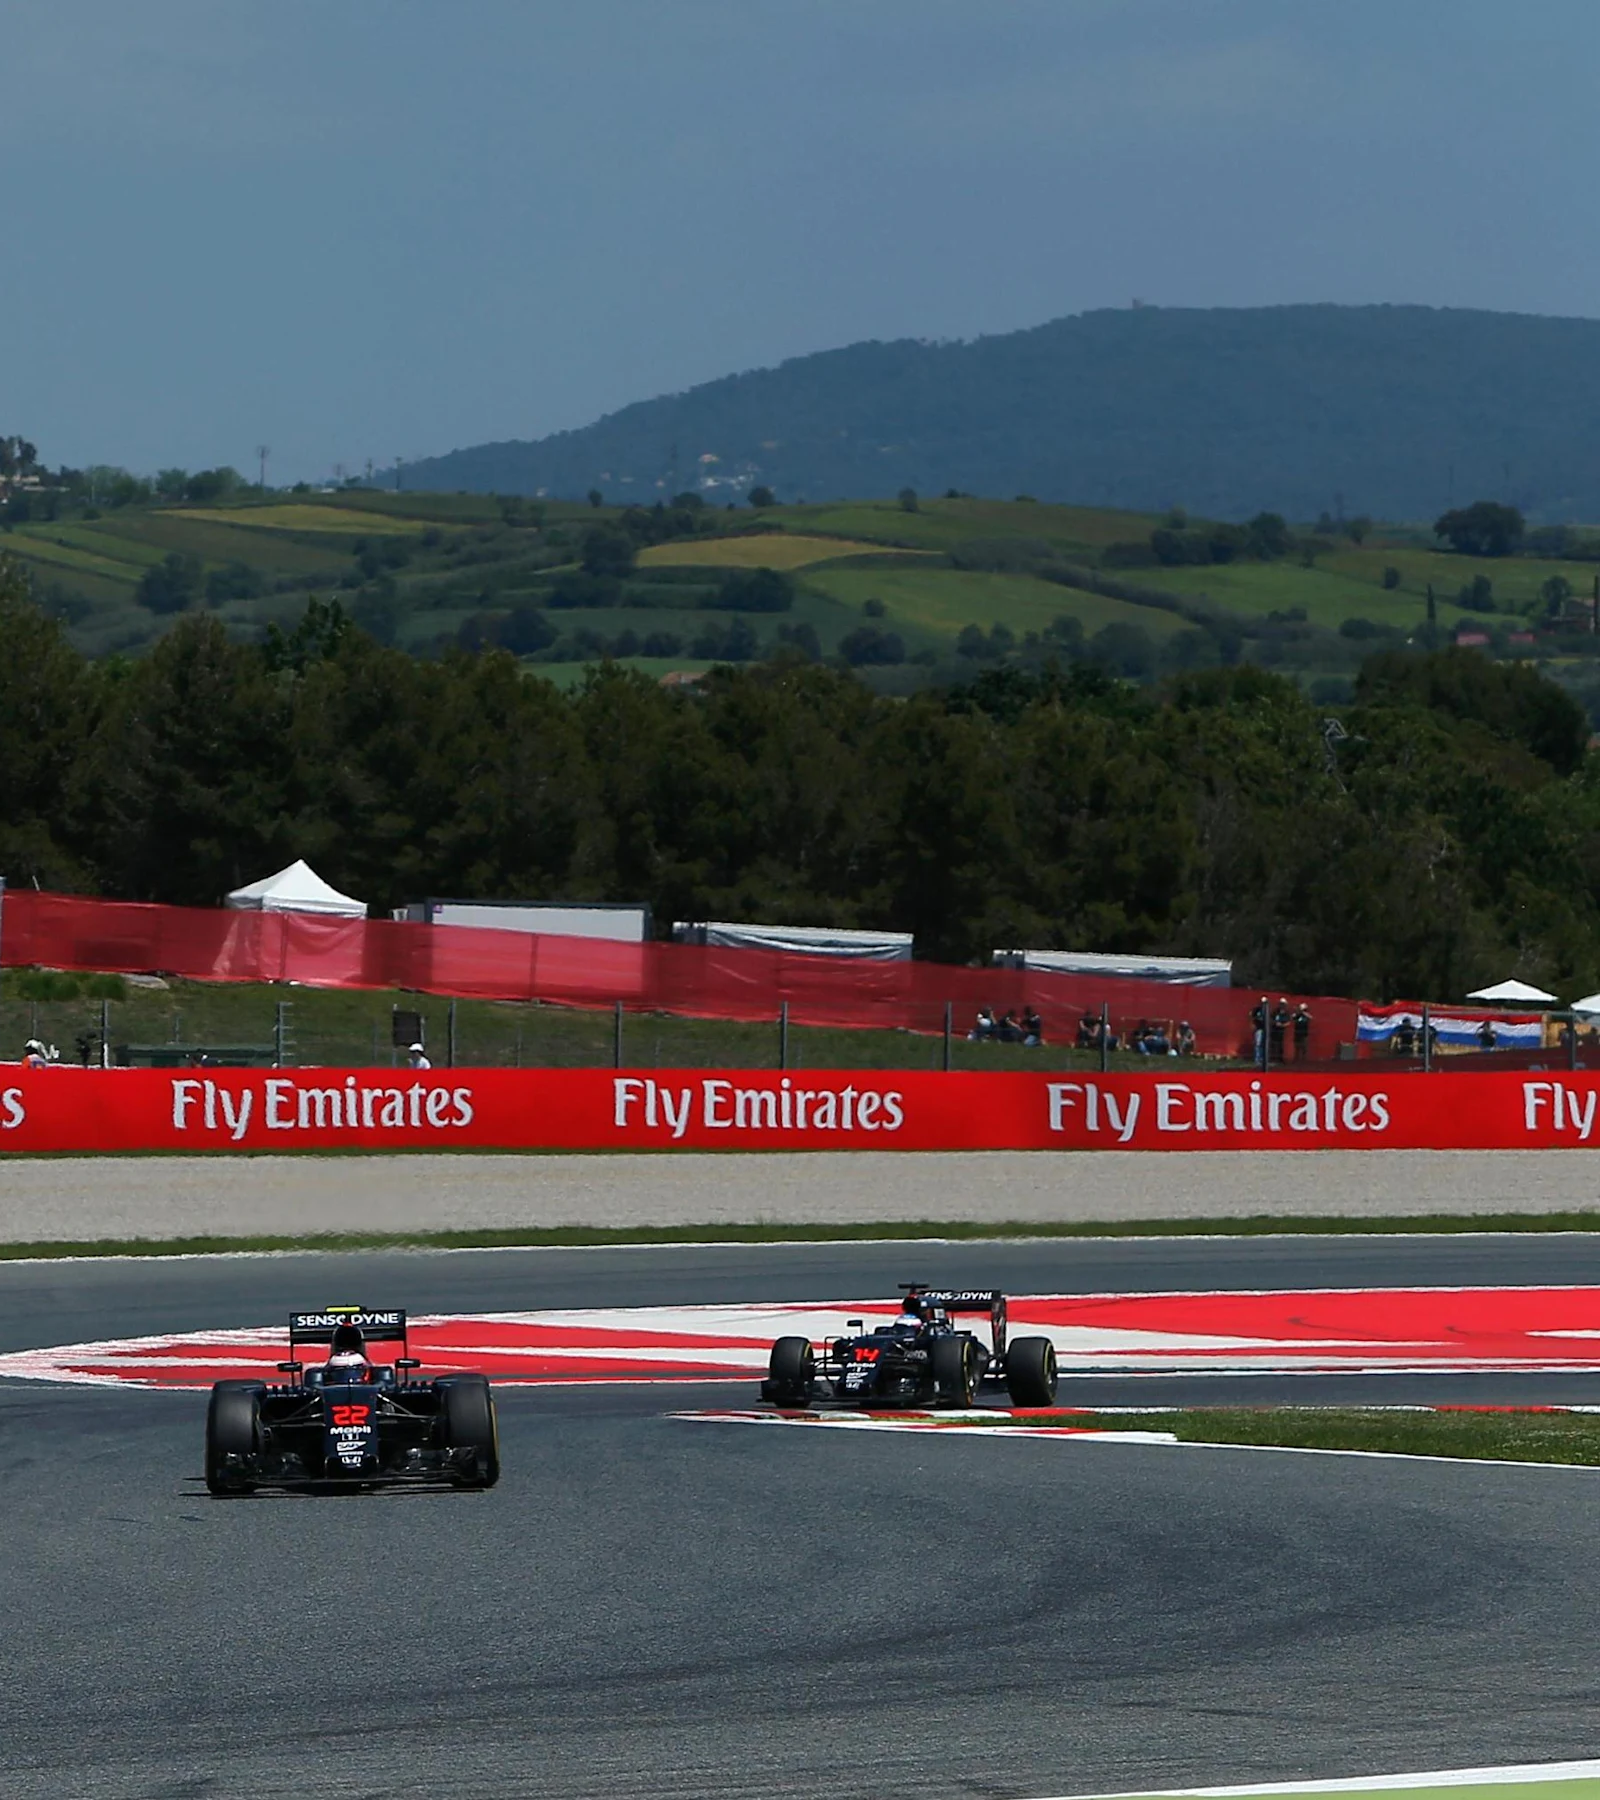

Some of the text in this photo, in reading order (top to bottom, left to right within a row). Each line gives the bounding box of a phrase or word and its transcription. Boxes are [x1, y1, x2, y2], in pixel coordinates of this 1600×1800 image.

[171, 1076, 473, 1140] Fly Emirates
[613, 1078, 903, 1138] Fly Emirates
[1046, 1080, 1390, 1142] Fly Emirates
[1523, 1082, 1596, 1139] Fly
[854, 1348, 879, 1361] 14
[330, 1425, 371, 1435] Mobil
[331, 1405, 369, 1425] 22
